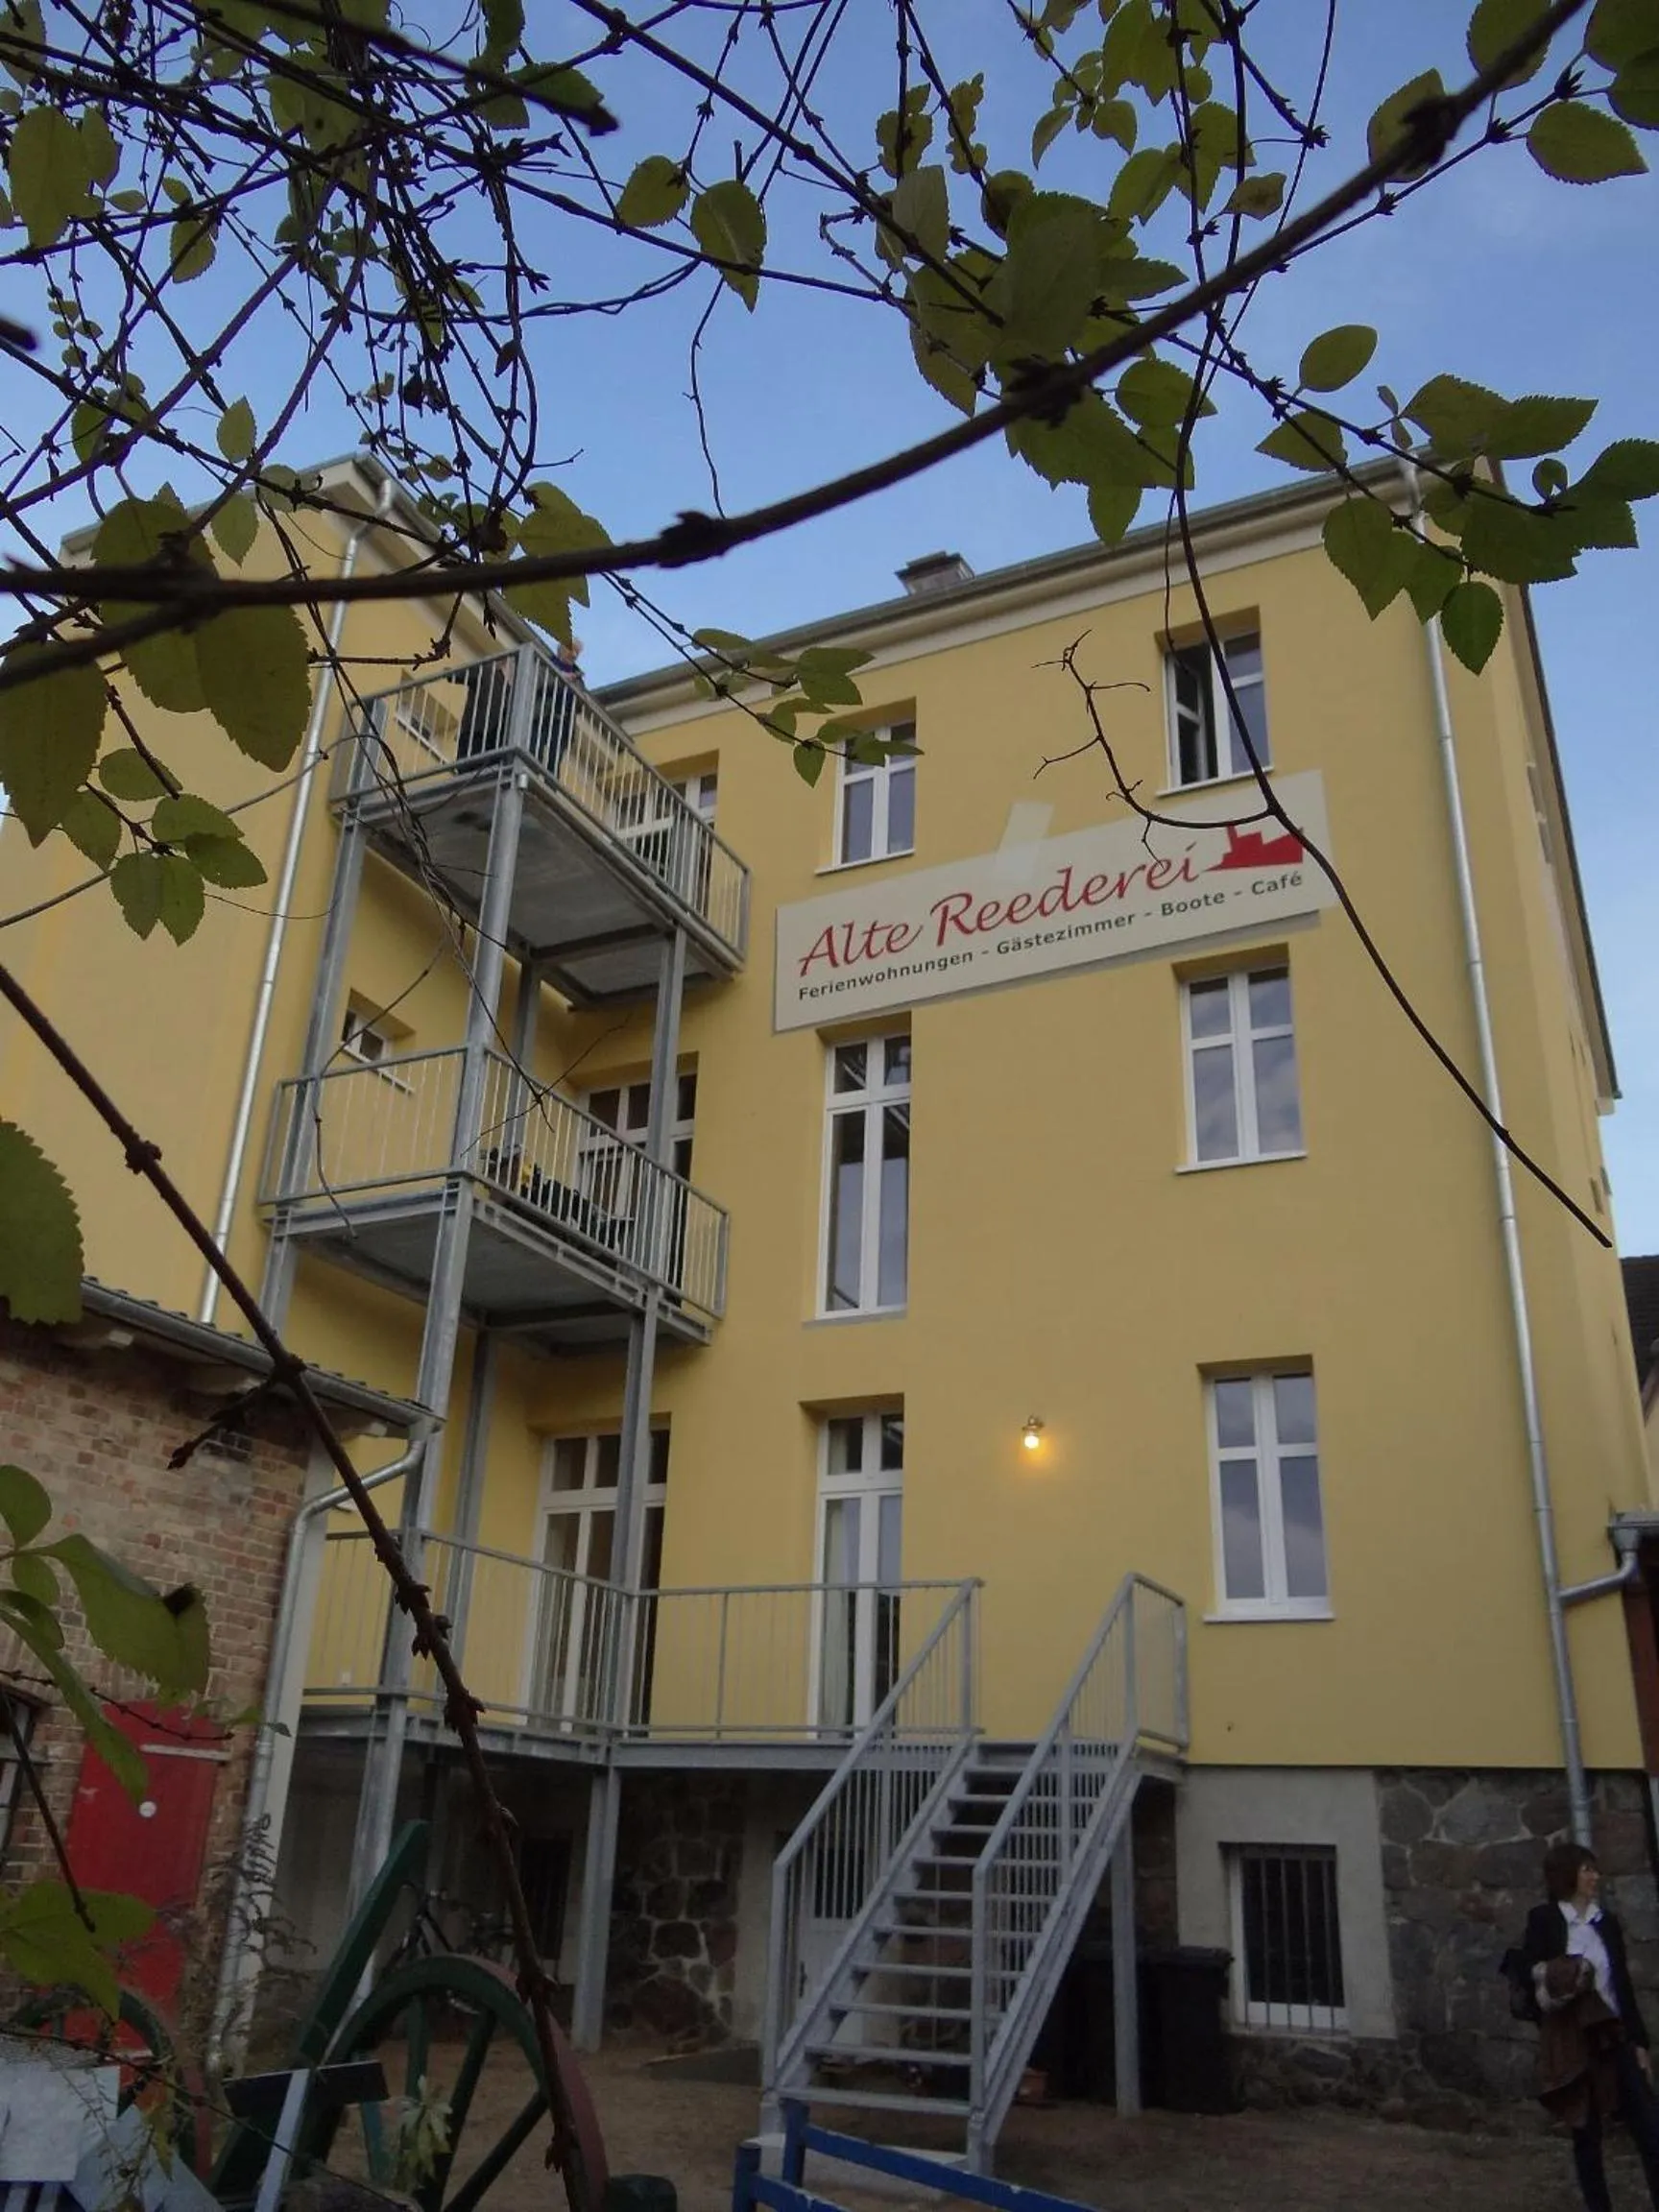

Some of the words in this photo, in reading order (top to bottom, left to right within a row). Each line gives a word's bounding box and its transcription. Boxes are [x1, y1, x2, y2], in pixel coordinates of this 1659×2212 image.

[798, 919, 924, 977] Alte
[929, 841, 1199, 948] Reederei
[798, 950, 974, 1000] Ferienwohnungen
[997, 913, 1135, 955] Gästezimmer
[1161, 890, 1225, 917] Boote
[1251, 871, 1303, 896] Café
